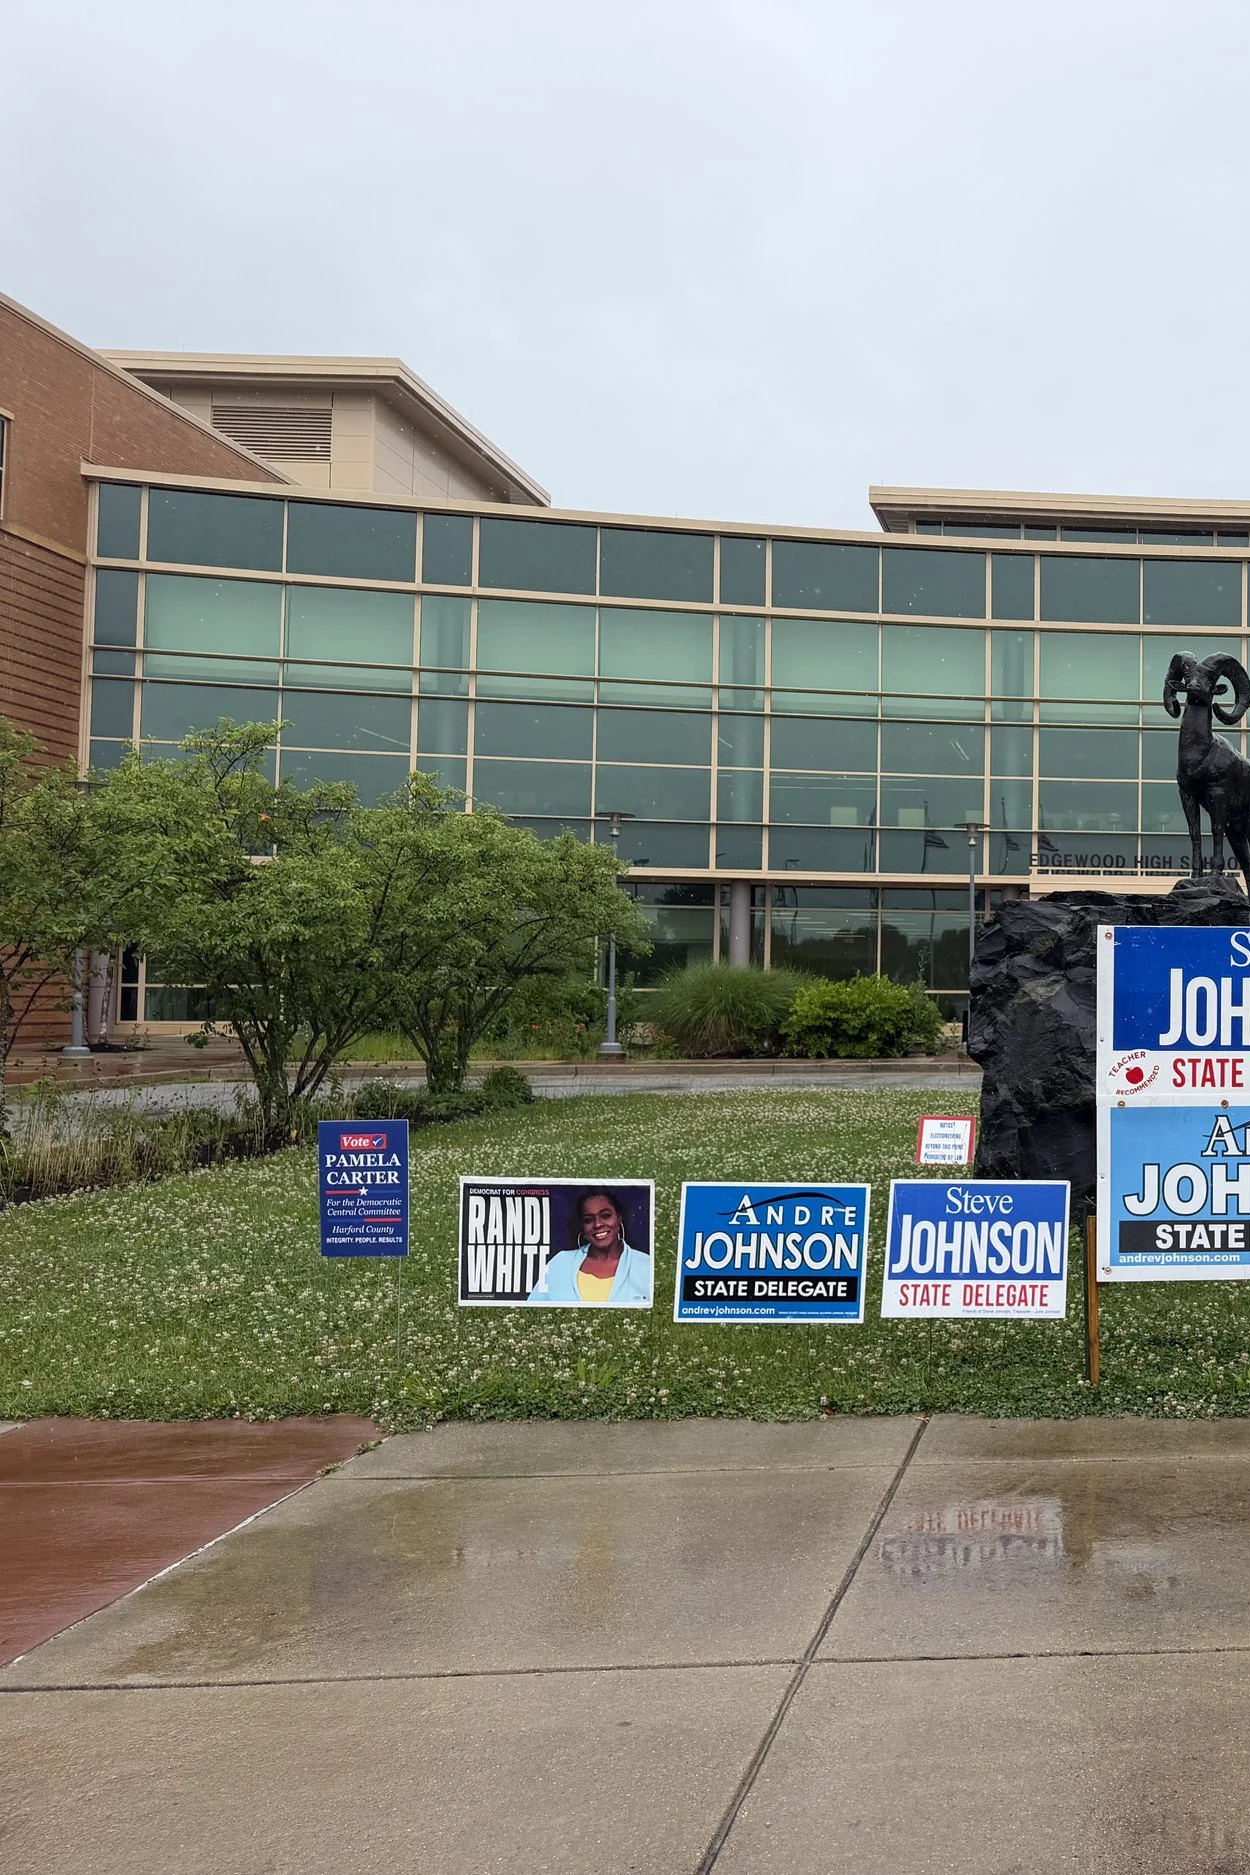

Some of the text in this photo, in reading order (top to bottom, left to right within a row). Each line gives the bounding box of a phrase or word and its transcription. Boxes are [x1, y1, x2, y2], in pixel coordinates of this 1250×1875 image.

[1029, 853, 1126, 868] EDGEWOOD
[1134, 855, 1172, 869] HIGH
[1108, 1051, 1146, 1077] TEACHER
[1172, 1058, 1245, 1088] STATE
[1115, 1065, 1160, 1096] RECOMMENDED
[342, 1136, 370, 1147] Vote
[325, 1153, 402, 1168] PAMELA
[326, 1171, 400, 1185] CARTER
[326, 1198, 402, 1207] For the Democratic
[728, 1194, 857, 1226] ANDRE
[945, 1186, 1014, 1214] Steve
[327, 1208, 401, 1216] Central Committee
[468, 1196, 550, 1244] RANDI
[332, 1225, 394, 1235] Harford County
[1155, 1223, 1245, 1249] STATE
[685, 1231, 859, 1270] JOHNSON
[891, 1214, 1062, 1274] JOHNSON
[467, 1244, 549, 1293] WHITE
[1118, 1253, 1241, 1264] andrevjohnson.com
[694, 1280, 848, 1297] STATE DELEGATE
[899, 1284, 1049, 1307] STATE DELEGATE
[681, 1306, 776, 1316] andrevjohnson.com
